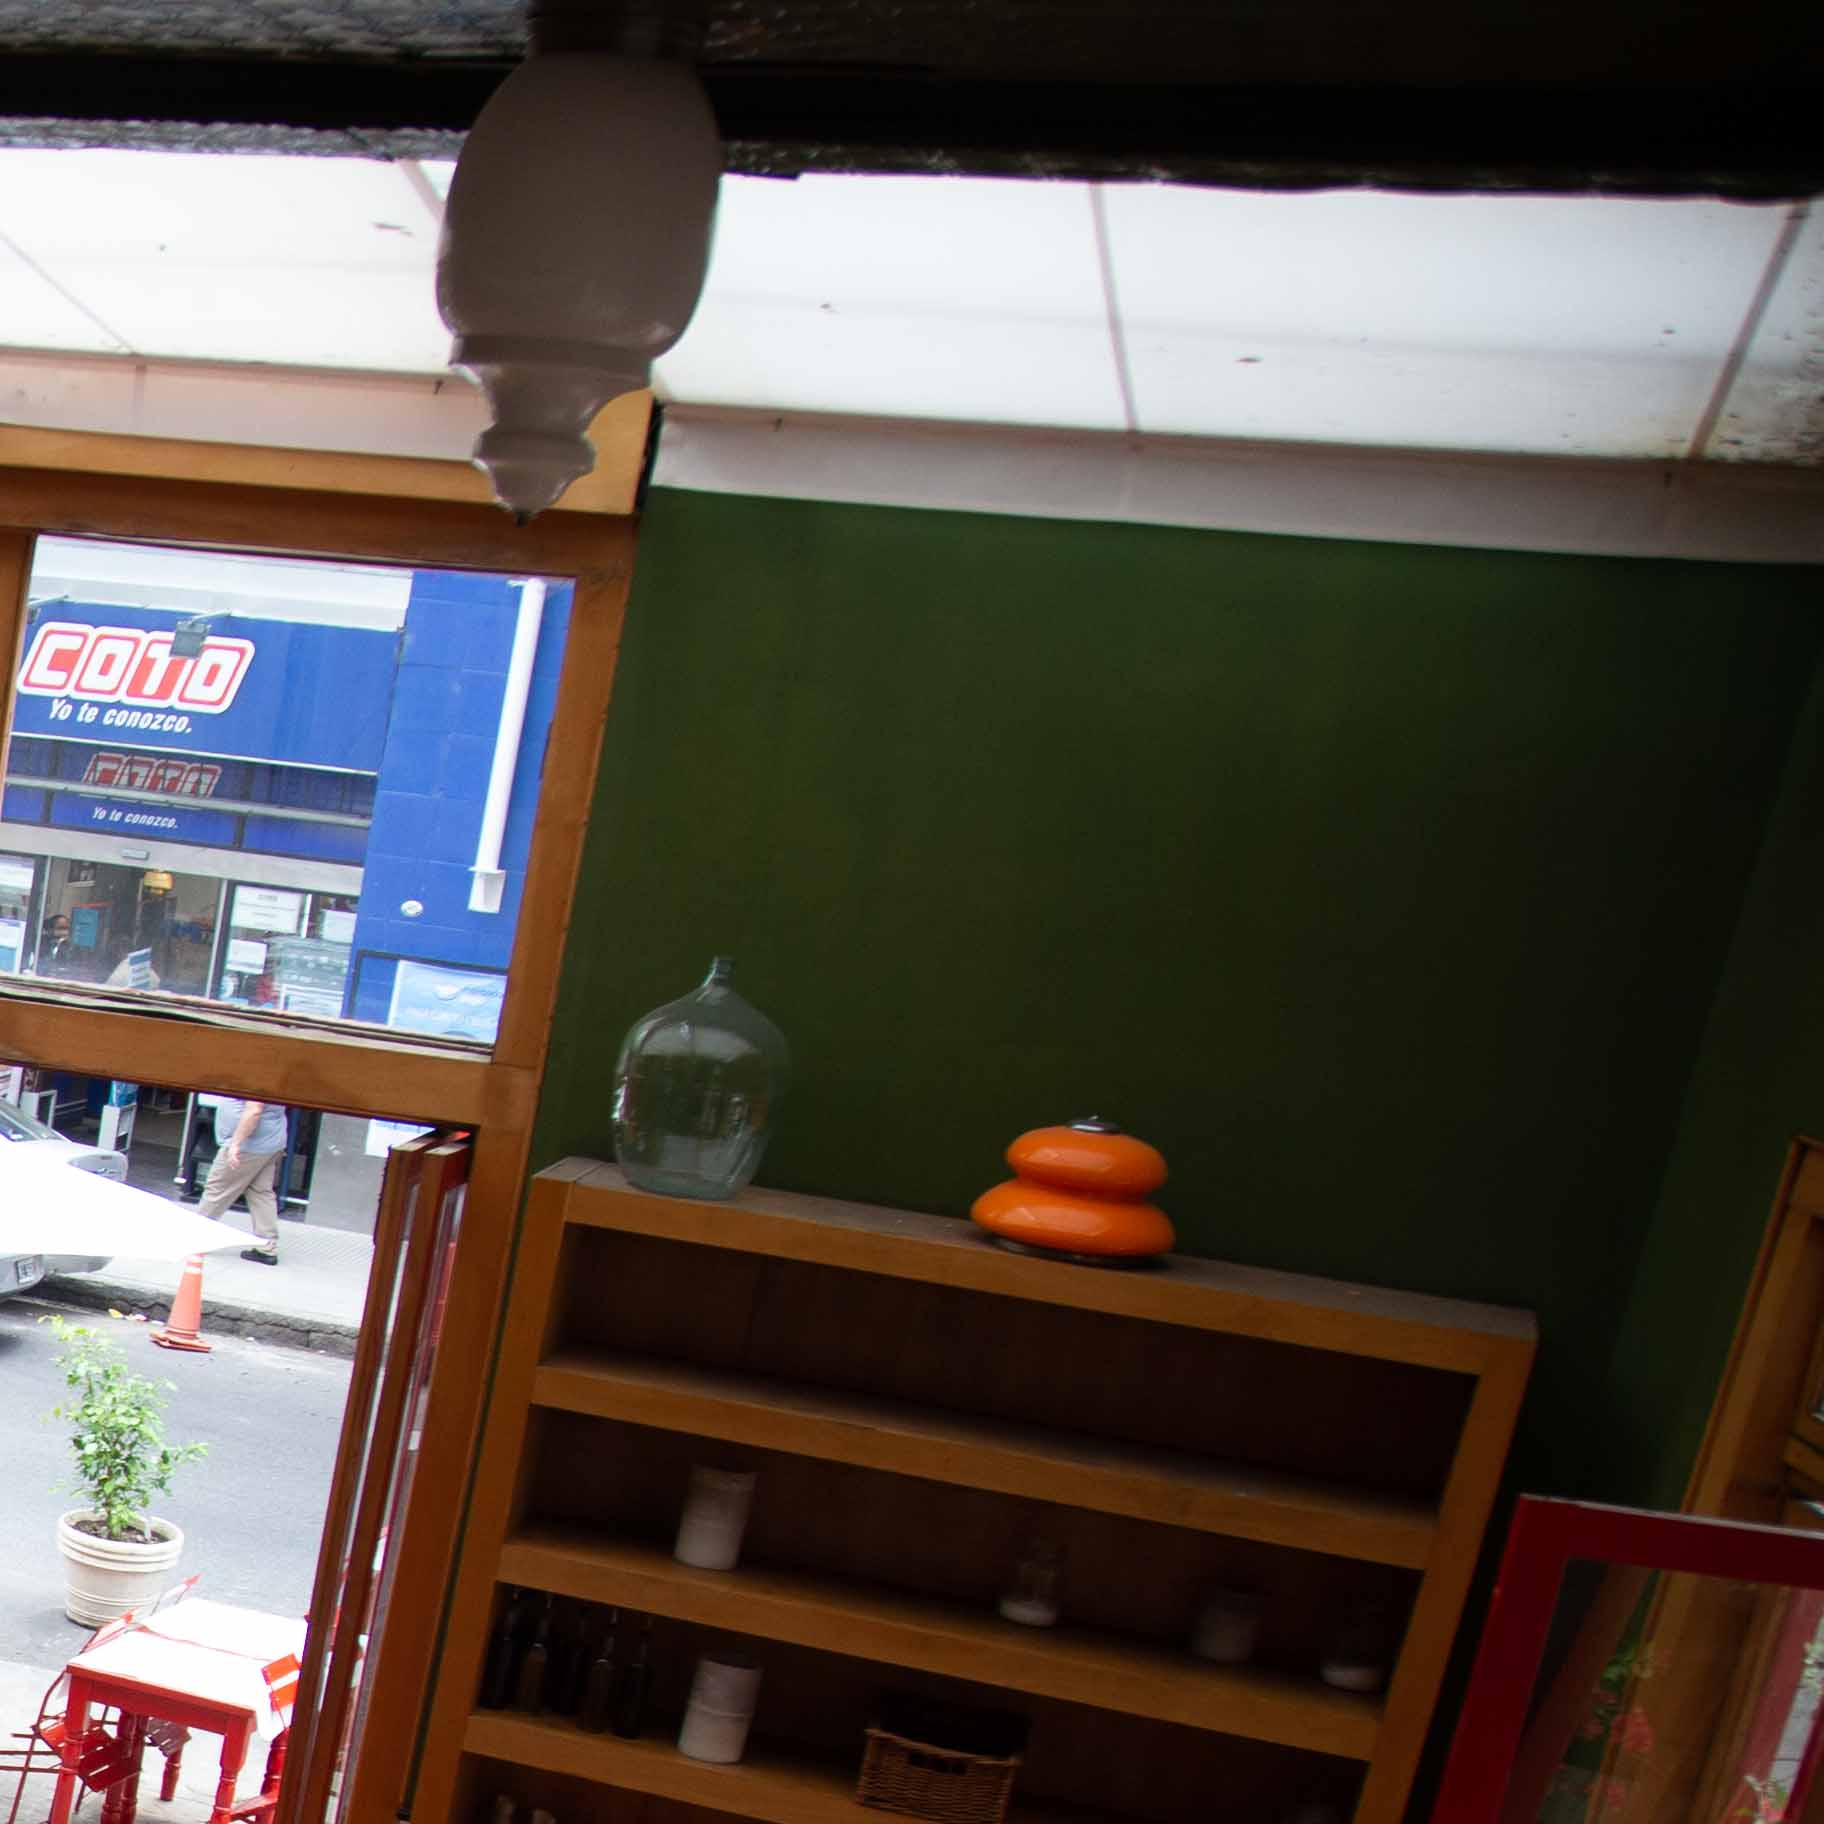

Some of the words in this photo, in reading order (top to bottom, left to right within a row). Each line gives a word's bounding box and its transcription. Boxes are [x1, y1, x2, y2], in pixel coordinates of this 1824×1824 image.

[19, 623, 254, 713] COTO
[49, 697, 73, 721] Yo
[77, 702, 97, 724] te
[102, 708, 193, 735] conozco.
[92, 806, 107, 820] Yo
[111, 809, 123, 822] te
